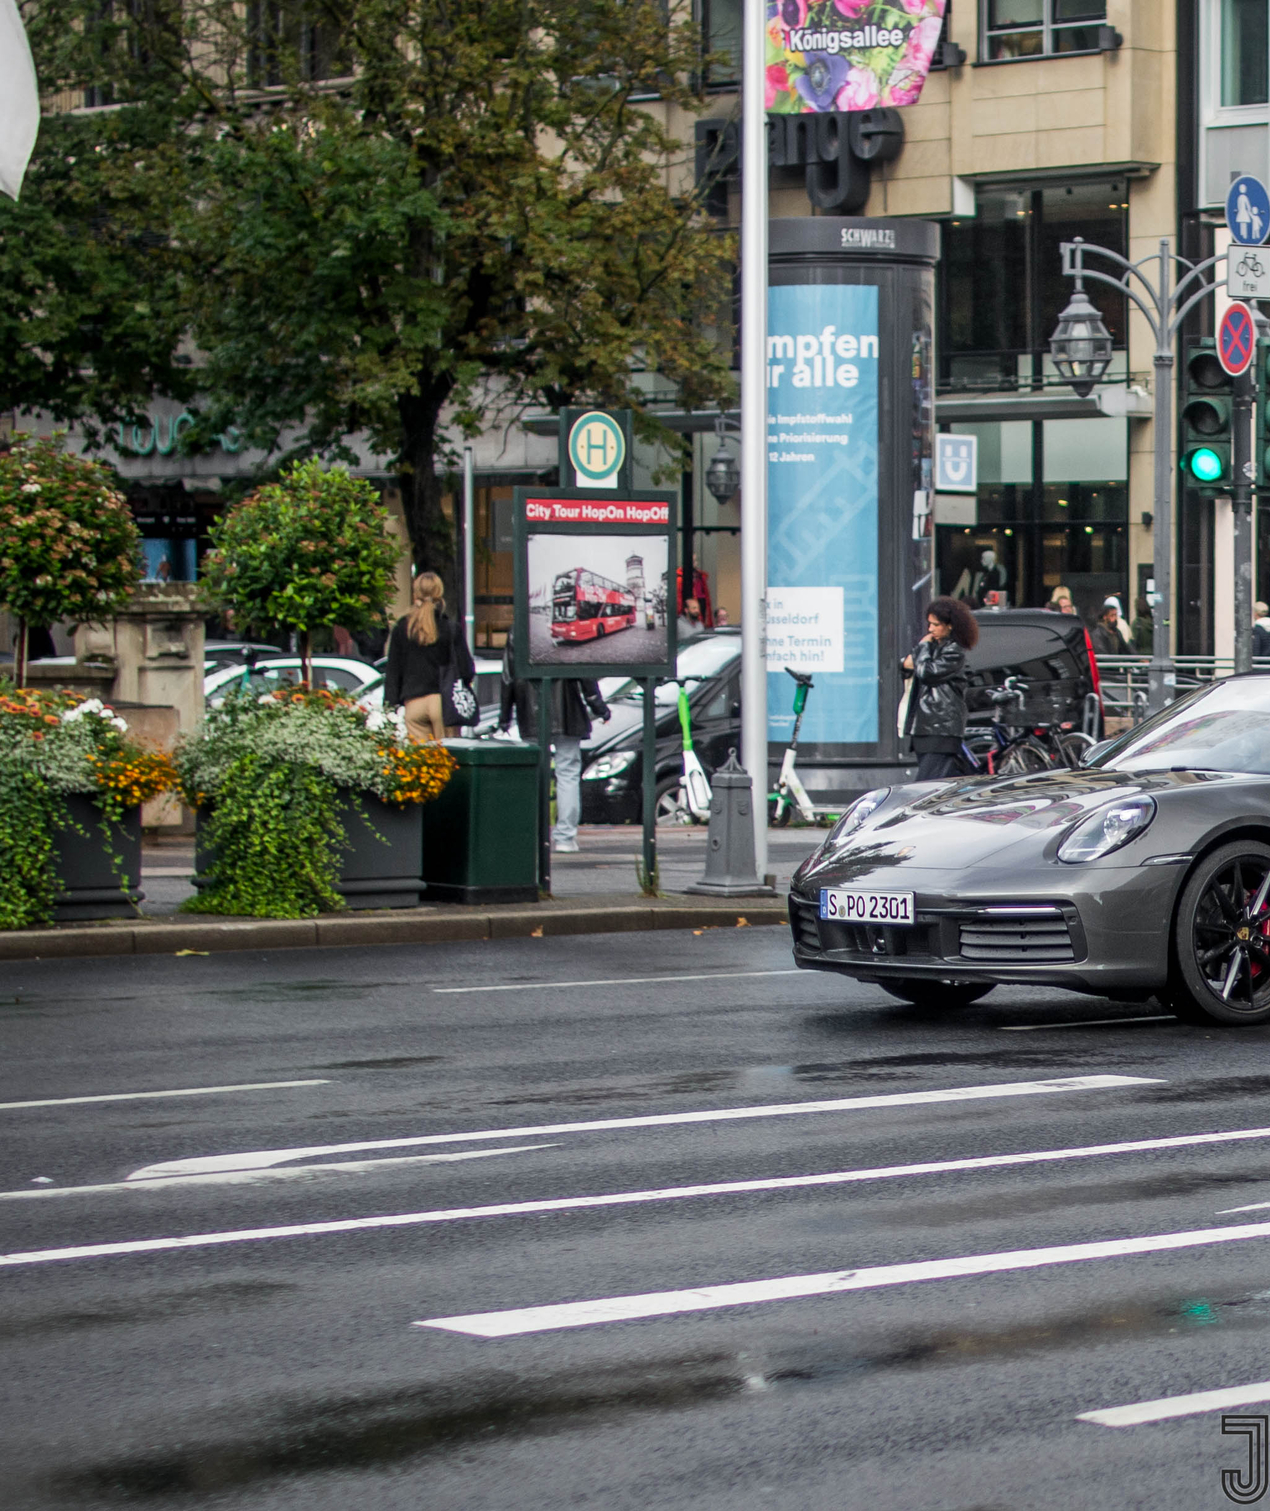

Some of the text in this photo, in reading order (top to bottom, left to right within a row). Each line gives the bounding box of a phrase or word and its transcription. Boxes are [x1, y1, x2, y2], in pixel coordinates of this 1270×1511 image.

[789, 26, 904, 54] Königsallee
[1242, 280, 1258, 292] frei
[767, 325, 879, 366] mpfen
[791, 355, 859, 388] alle
[777, 413, 853, 426] Impfstoffwahl
[779, 432, 848, 445] Priorisierung
[587, 429, 607, 466] H
[769, 452, 815, 462] 12 Jahren
[526, 503, 669, 522] City Tour HopOn HopOff
[766, 613, 819, 625] üsseldorf
[788, 635, 832, 647] Termin
[766, 650, 824, 662] nfach hin!
[829, 894, 910, 920] S PO 2301
